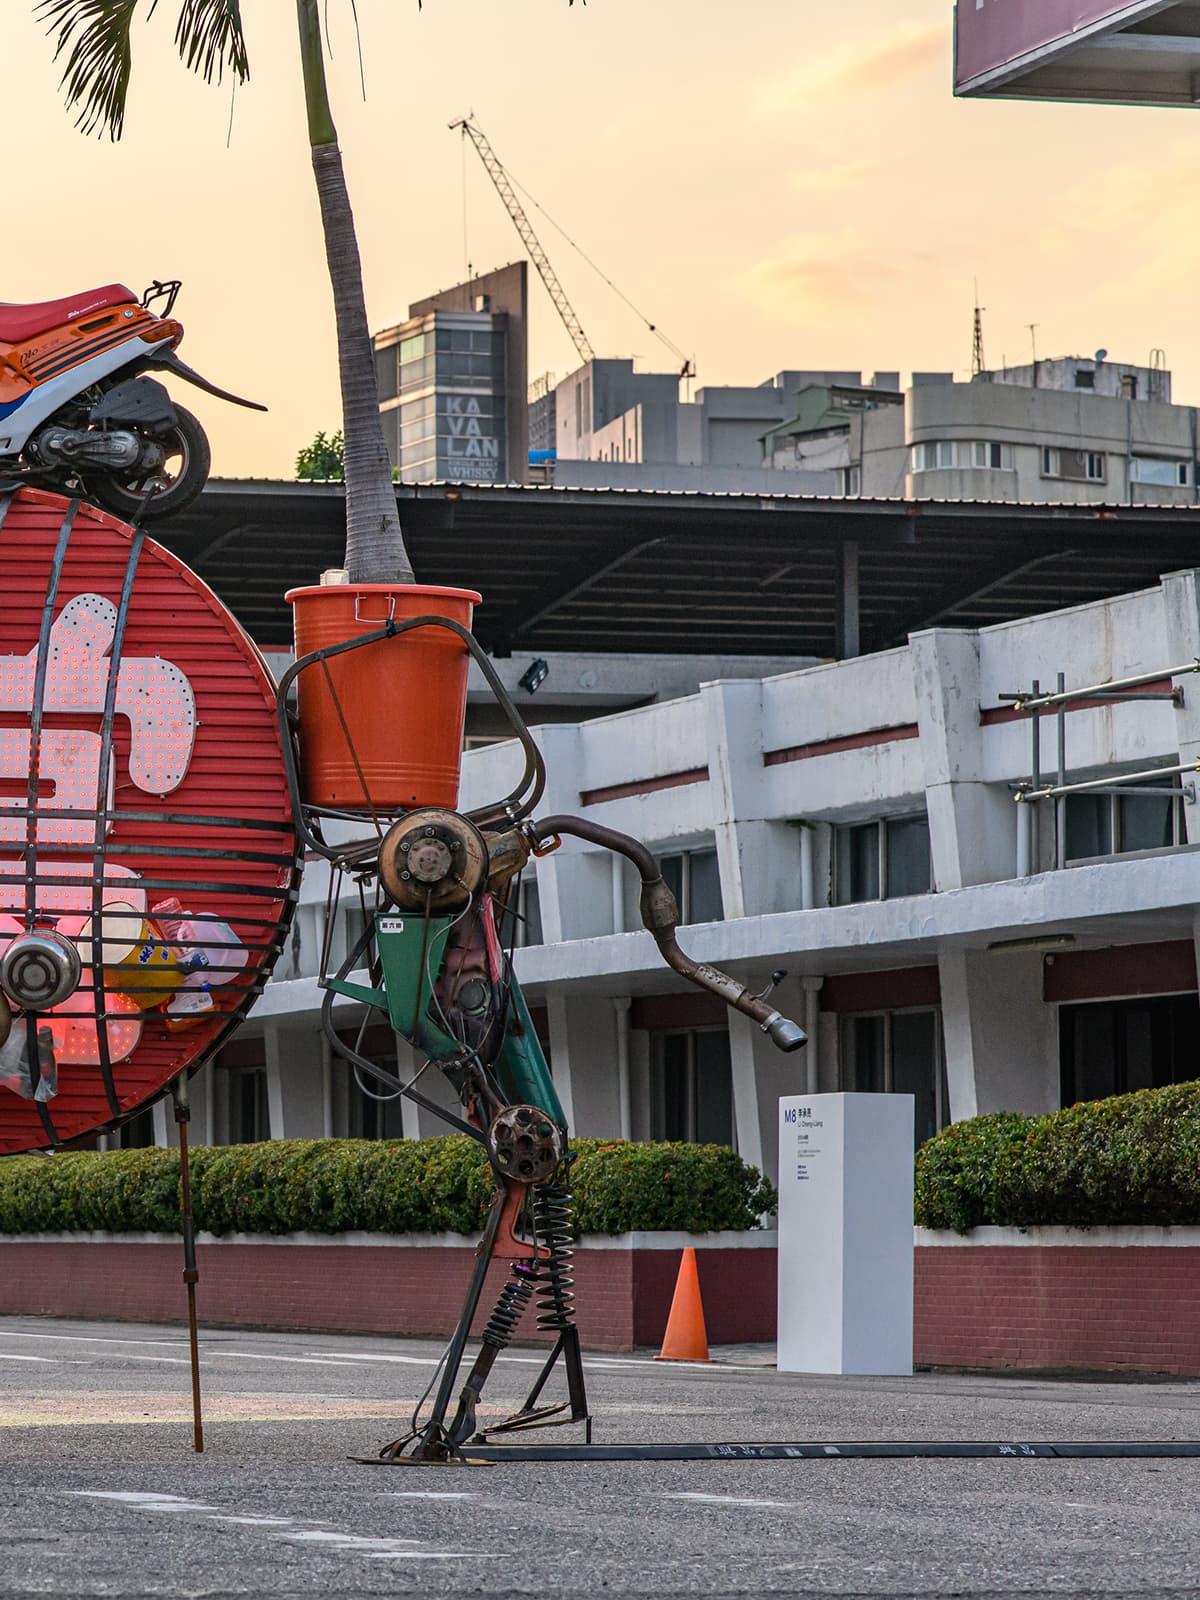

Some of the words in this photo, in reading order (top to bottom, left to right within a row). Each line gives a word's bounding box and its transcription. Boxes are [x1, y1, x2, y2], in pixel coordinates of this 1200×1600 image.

[446, 397, 481, 414] KA
[446, 416, 482, 436] VA
[447, 437, 499, 457] LAN
[448, 466, 499, 480] WHISKY
[784, 1108, 797, 1123] M8
